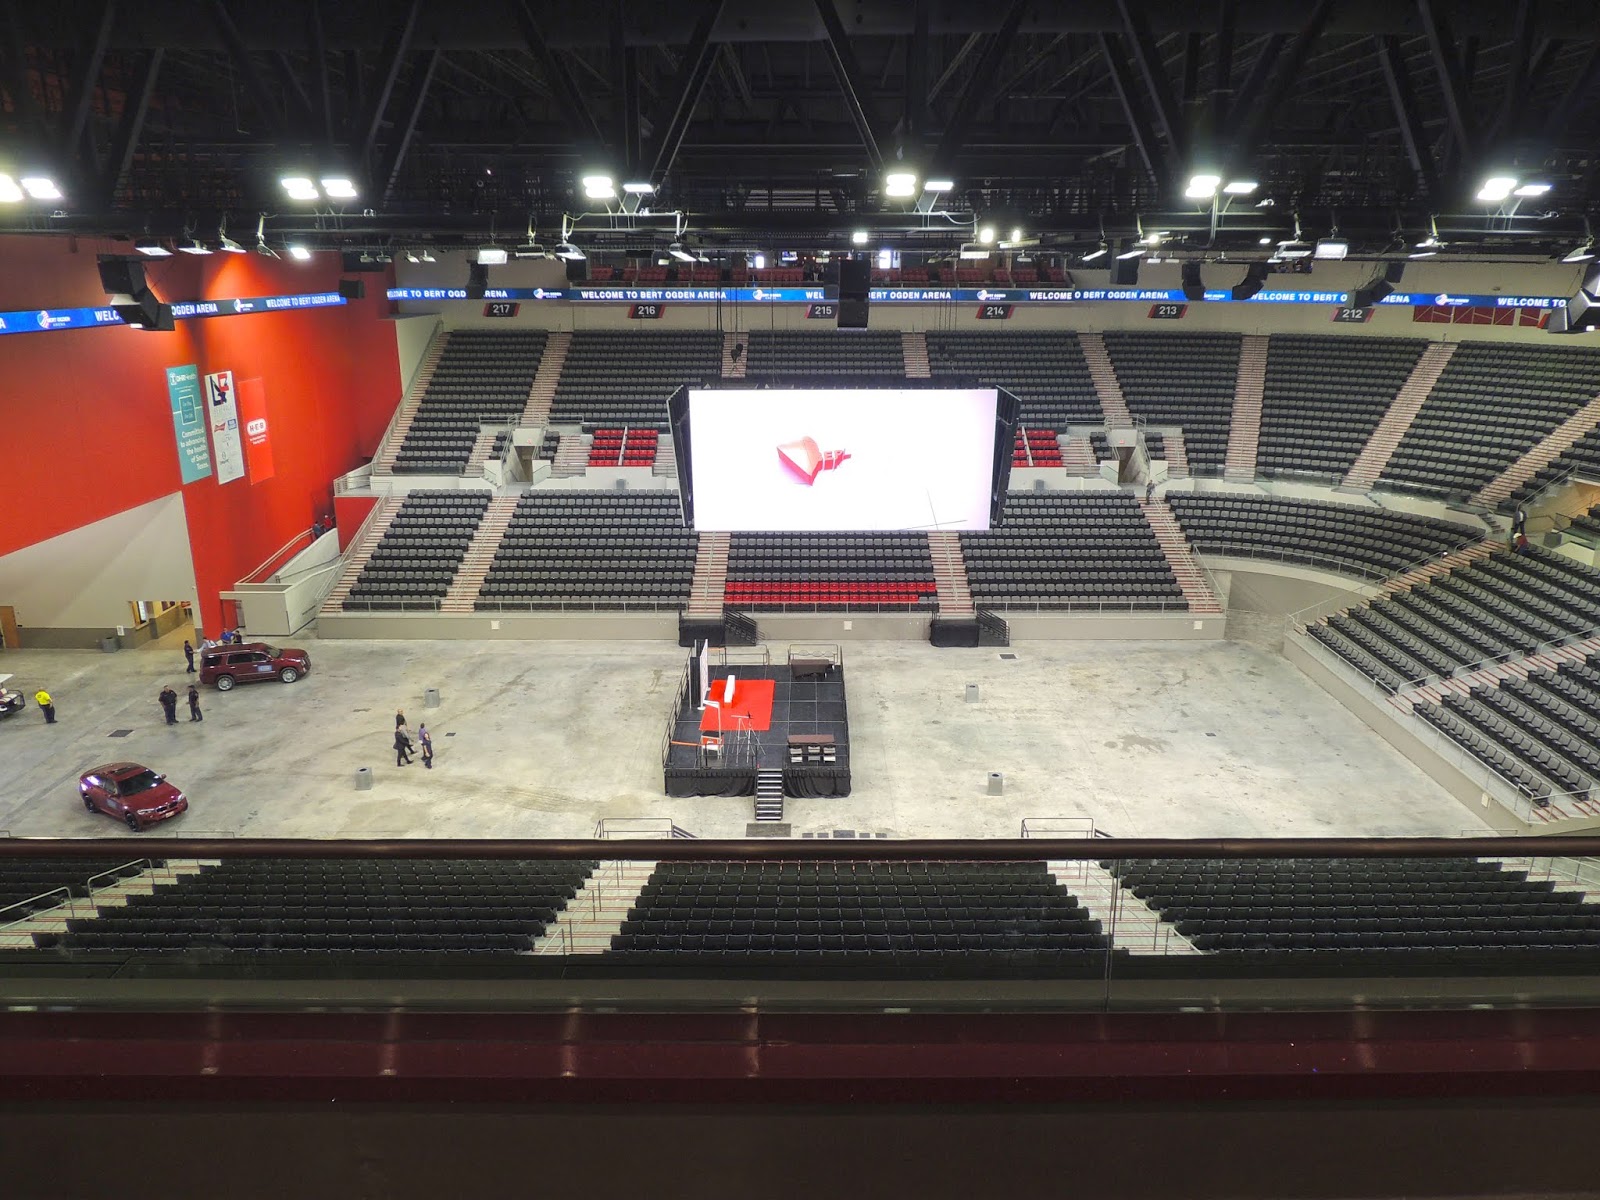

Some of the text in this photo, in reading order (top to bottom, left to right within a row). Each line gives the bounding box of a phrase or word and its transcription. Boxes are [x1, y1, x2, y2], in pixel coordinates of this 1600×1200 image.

[410, 290, 422, 298] TO
[423, 290, 446, 298] BERT
[447, 290, 467, 298] OGD
[483, 290, 508, 298] RENA
[580, 291, 727, 299] WELCOME TO BERT OGDEN ARENA
[889, 291, 920, 299] OGDEN
[922, 291, 952, 299] ARENA
[1029, 292, 1072, 300] WELCOME
[1083, 291, 1106, 299] BERT
[1107, 291, 1138, 299] OGDEN
[1139, 291, 1169, 299] ARENA
[1298, 293, 1311, 301] TO
[1313, 293, 1338, 301] BERT
[265, 298, 291, 308] WELCOME
[291, 297, 299, 306] TO
[299, 296, 311, 305] BERT
[311, 295, 326, 304] OGDEN
[1497, 297, 1567, 308] WELCOME TO
[94, 303, 218, 322] WELC OGDEN ARENA
[492, 304, 510, 313] 217
[638, 306, 656, 315] 216
[815, 306, 832, 315] 215
[986, 306, 1004, 315] 214
[1159, 306, 1177, 315] 213
[1342, 309, 1363, 318] 212
